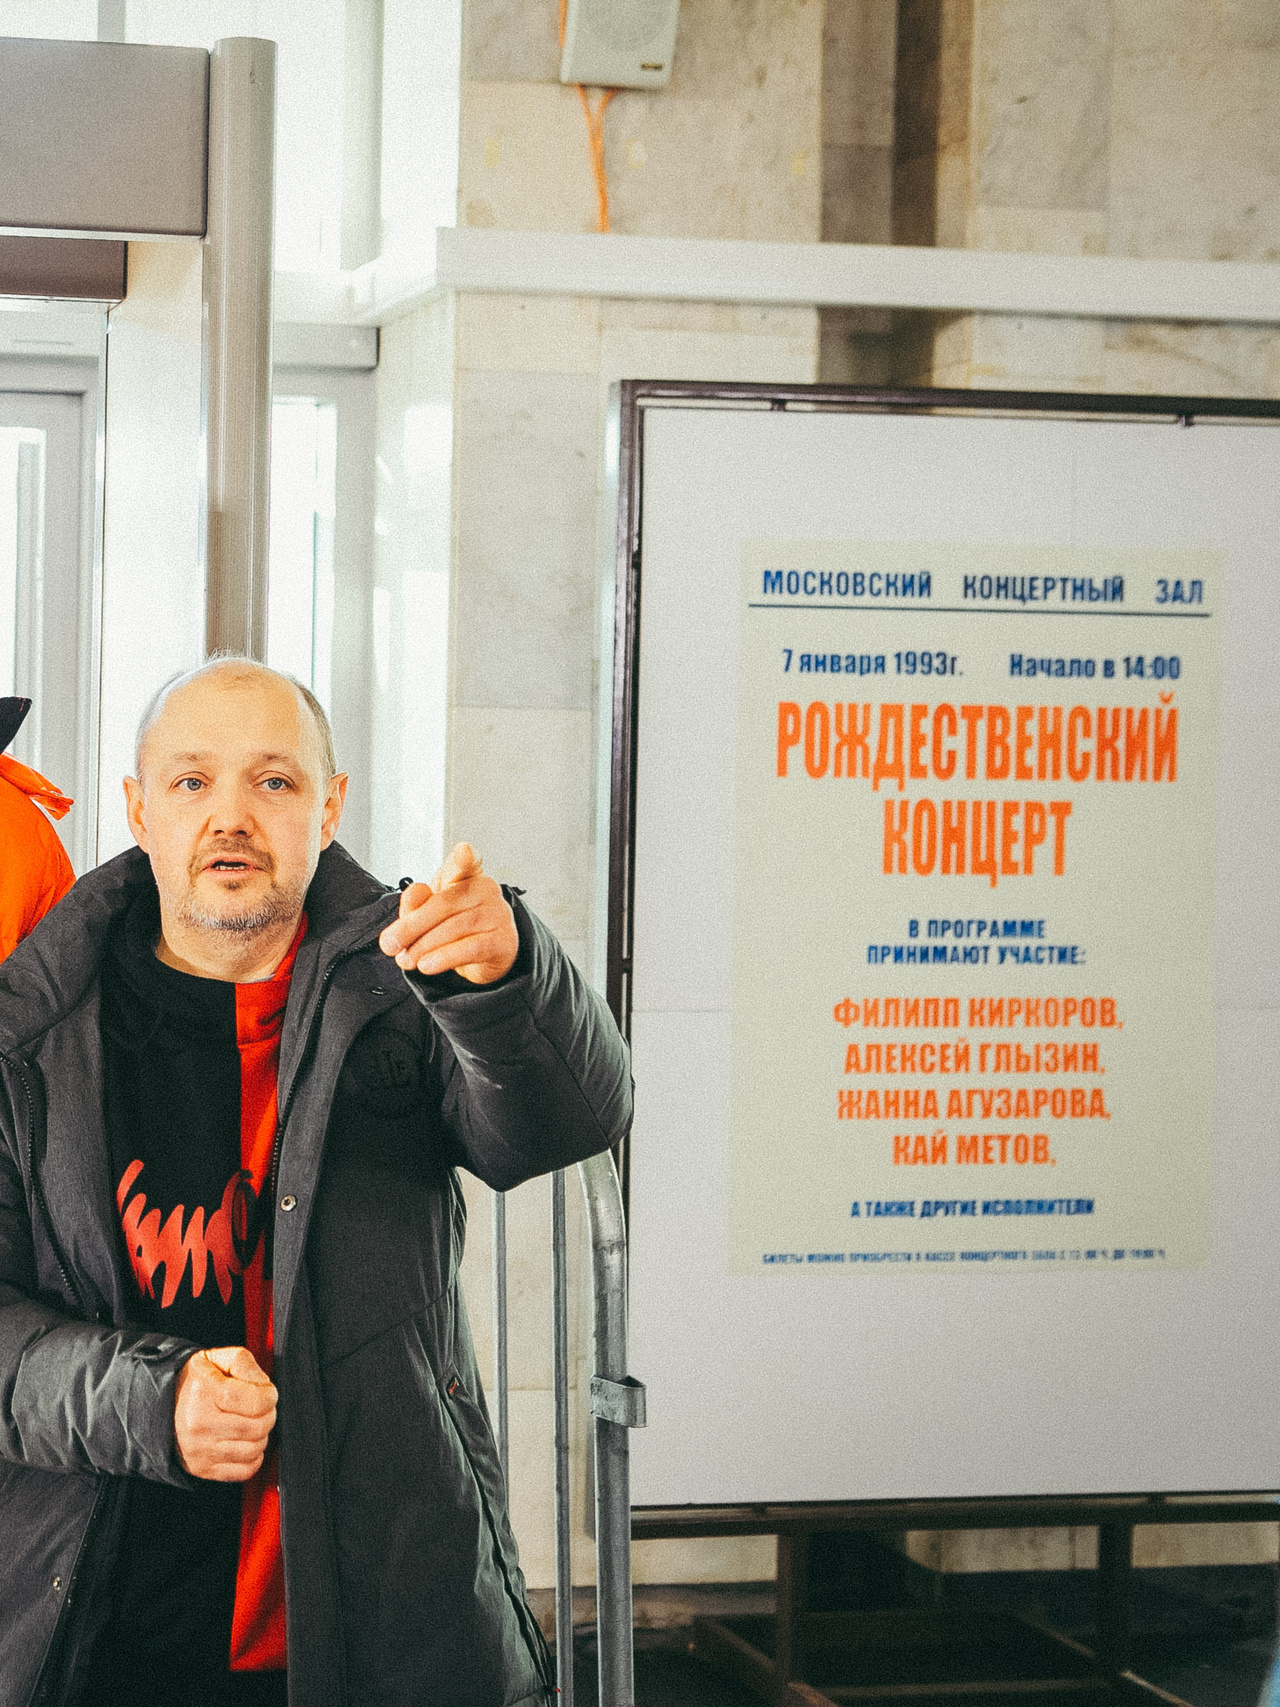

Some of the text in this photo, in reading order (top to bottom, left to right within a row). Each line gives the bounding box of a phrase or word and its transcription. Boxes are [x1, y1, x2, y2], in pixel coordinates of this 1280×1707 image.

[762, 570, 1205, 606] МОСКОВСКИЙ КОНЦЕРТНЫЙ ЗАЛ
[782, 649, 1182, 681] 7 января 1993г. Начало в 14:00
[776, 692, 1180, 793] РОЖДЕСТВЕНСКИЙ
[882, 799, 1074, 889] КОНЦЕРТ
[908, 919, 1046, 940] В ПРОГРАММЕ
[866, 945, 990, 966] ПРИНИМАЮТ
[833, 997, 1124, 1031] ФИЛИПП КИРКОРОВ,
[844, 1038, 1106, 1075] АЛЕКСЕЙ ГЛЫЗИН,
[837, 1088, 1112, 1122] ЖАННА АГУЗАРОВА,
[893, 1130, 1058, 1168] КАЙ МЕТОВ,
[850, 1198, 1095, 1219] А ТАКЖЕ ДРУГИЕ ИСПОЛНИТЕЛИ
